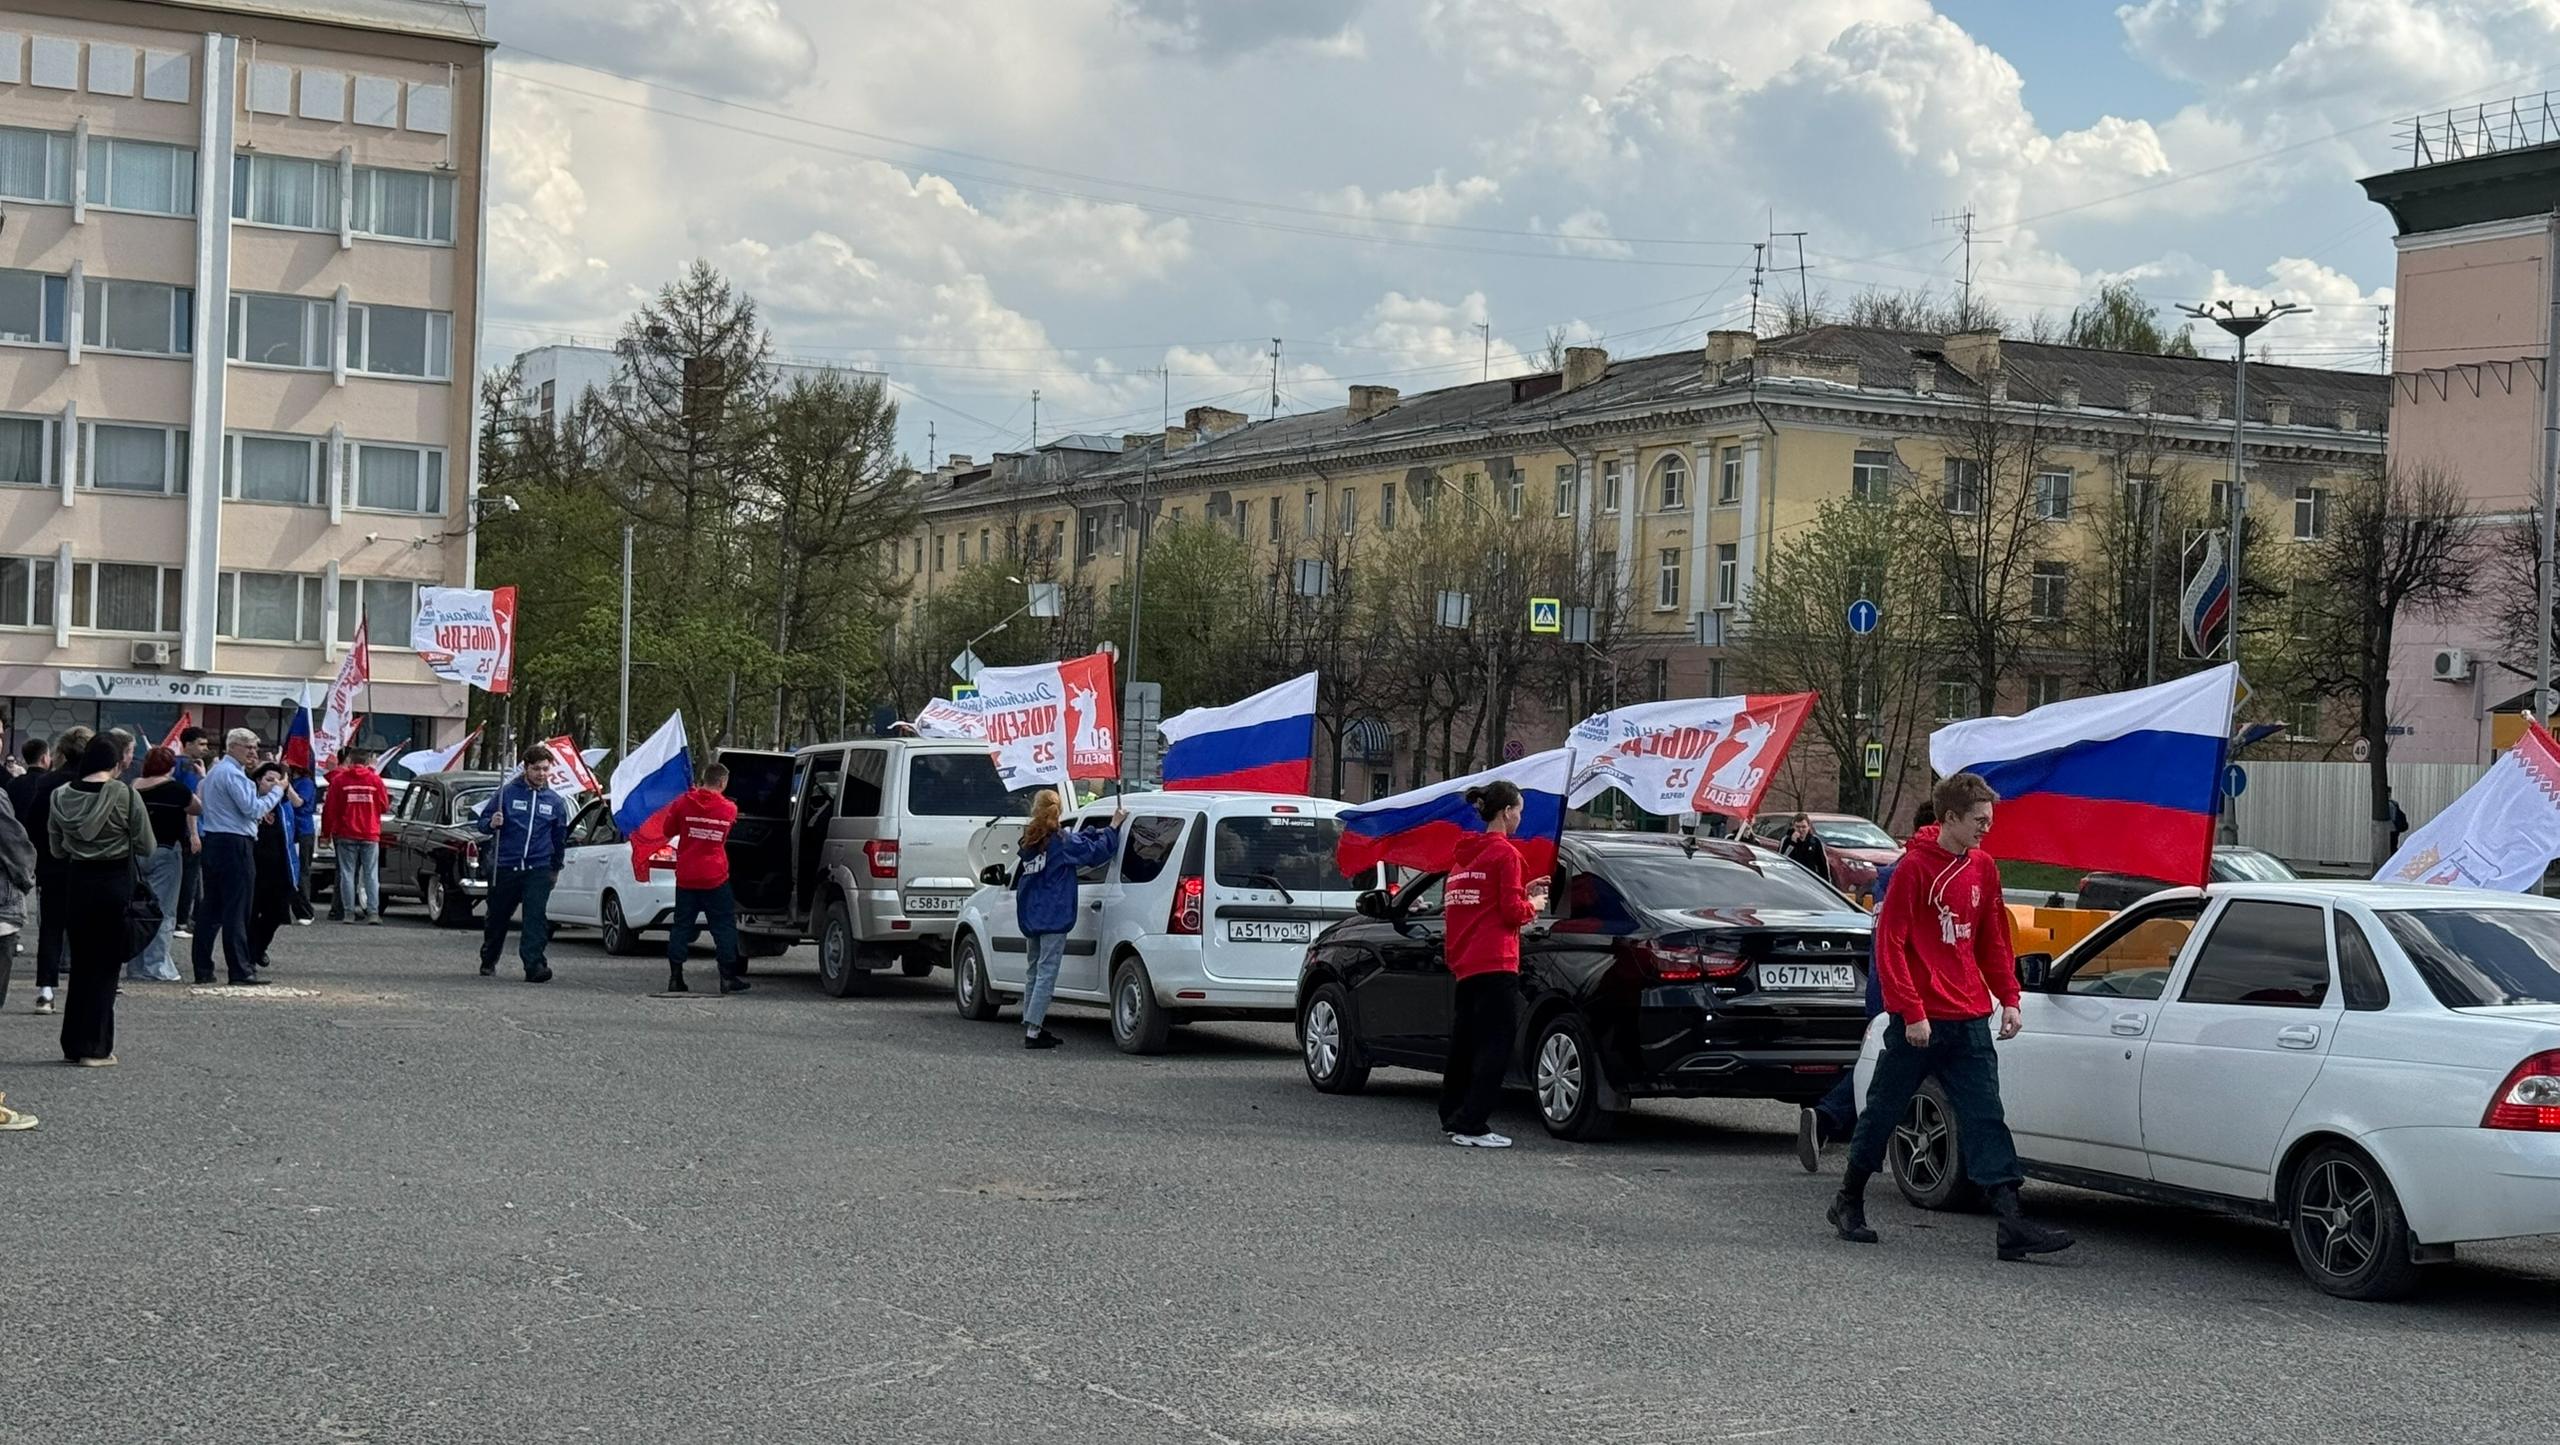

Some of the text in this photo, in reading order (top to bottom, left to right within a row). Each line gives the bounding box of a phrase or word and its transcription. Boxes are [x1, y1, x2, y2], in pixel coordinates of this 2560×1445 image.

[168, 682, 191, 695] 90
[193, 683, 224, 697] ЛЕТ
[2354, 744, 2367, 757] 40
[909, 897, 955, 909] С583ВТ
[1235, 923, 1305, 938] А511УО 12
[1766, 966, 1849, 985] О677ХН 12
